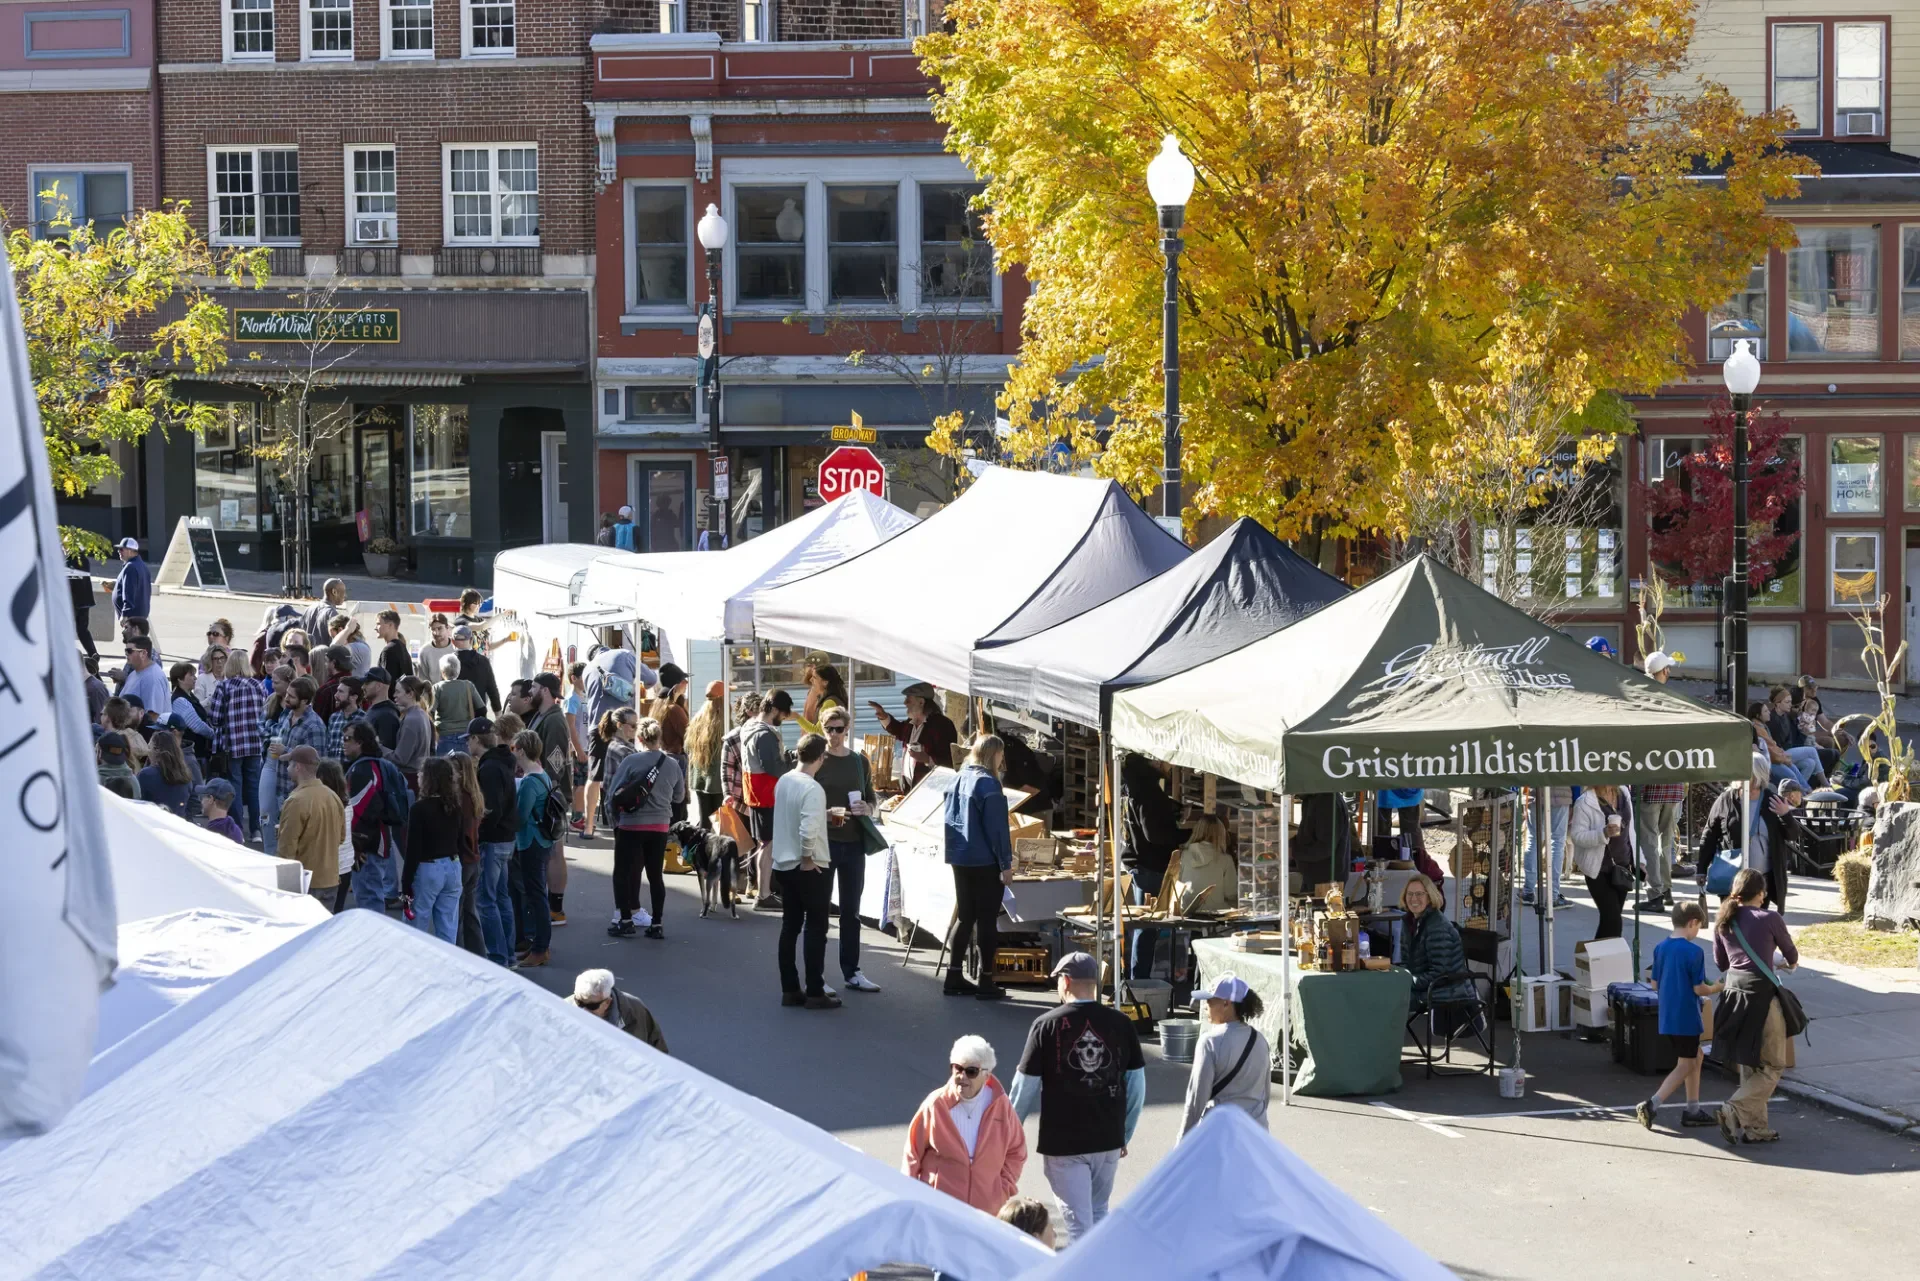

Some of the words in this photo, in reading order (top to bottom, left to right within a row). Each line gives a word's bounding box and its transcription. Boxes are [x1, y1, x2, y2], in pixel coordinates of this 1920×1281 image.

[358, 314, 387, 324] ARTS
[318, 325, 394, 338] GALLERY
[833, 428, 874, 441] BROADWAY
[715, 461, 728, 474] STOP
[823, 467, 880, 493] STOP
[1836, 489, 1872, 499] HOME
[1381, 635, 1550, 690] Gristmill
[1465, 668, 1572, 688] distillers
[1321, 738, 1718, 779] Gristmilldistillers.com
